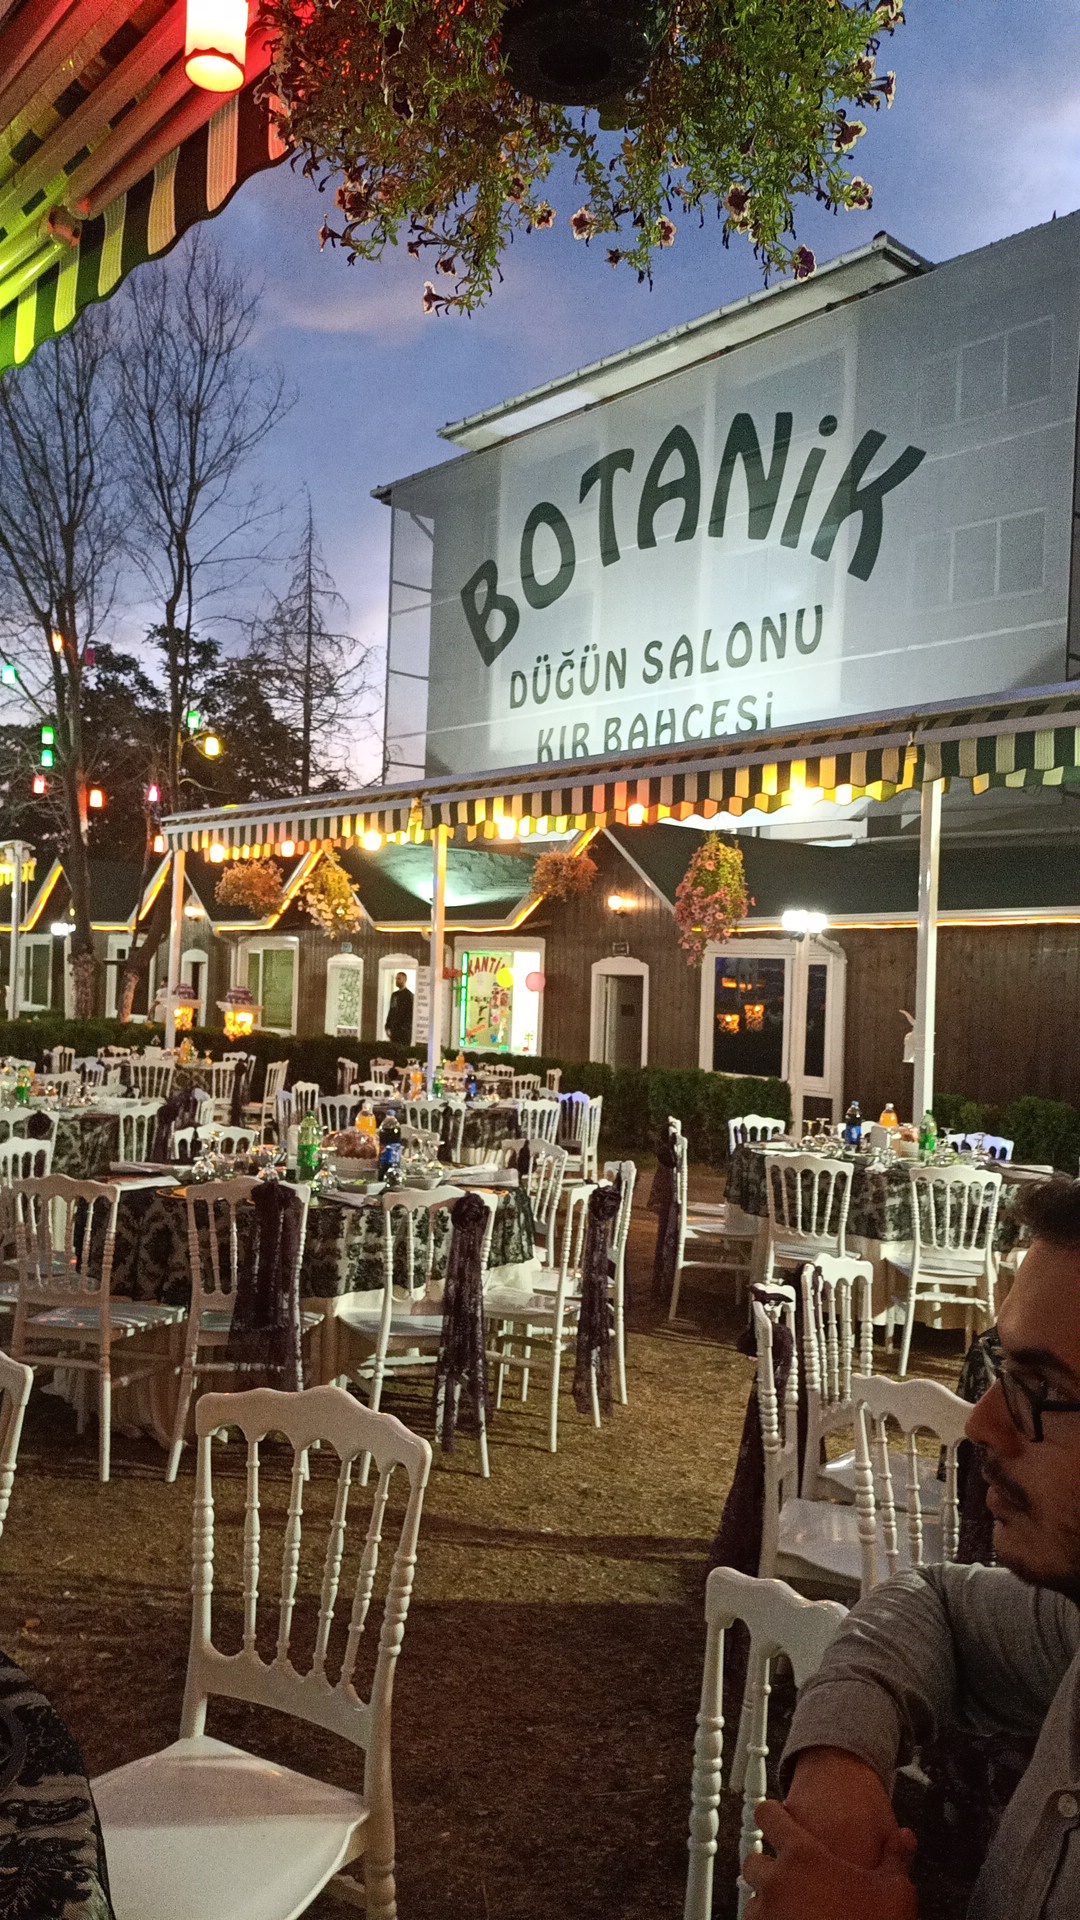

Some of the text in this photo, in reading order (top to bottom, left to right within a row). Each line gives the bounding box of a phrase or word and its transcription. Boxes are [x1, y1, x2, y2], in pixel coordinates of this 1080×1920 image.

[510, 604, 823, 709] DÜĞÜN SALONU
[537, 722, 590, 764] KIR
[468, 956, 506, 978] KANTİ
